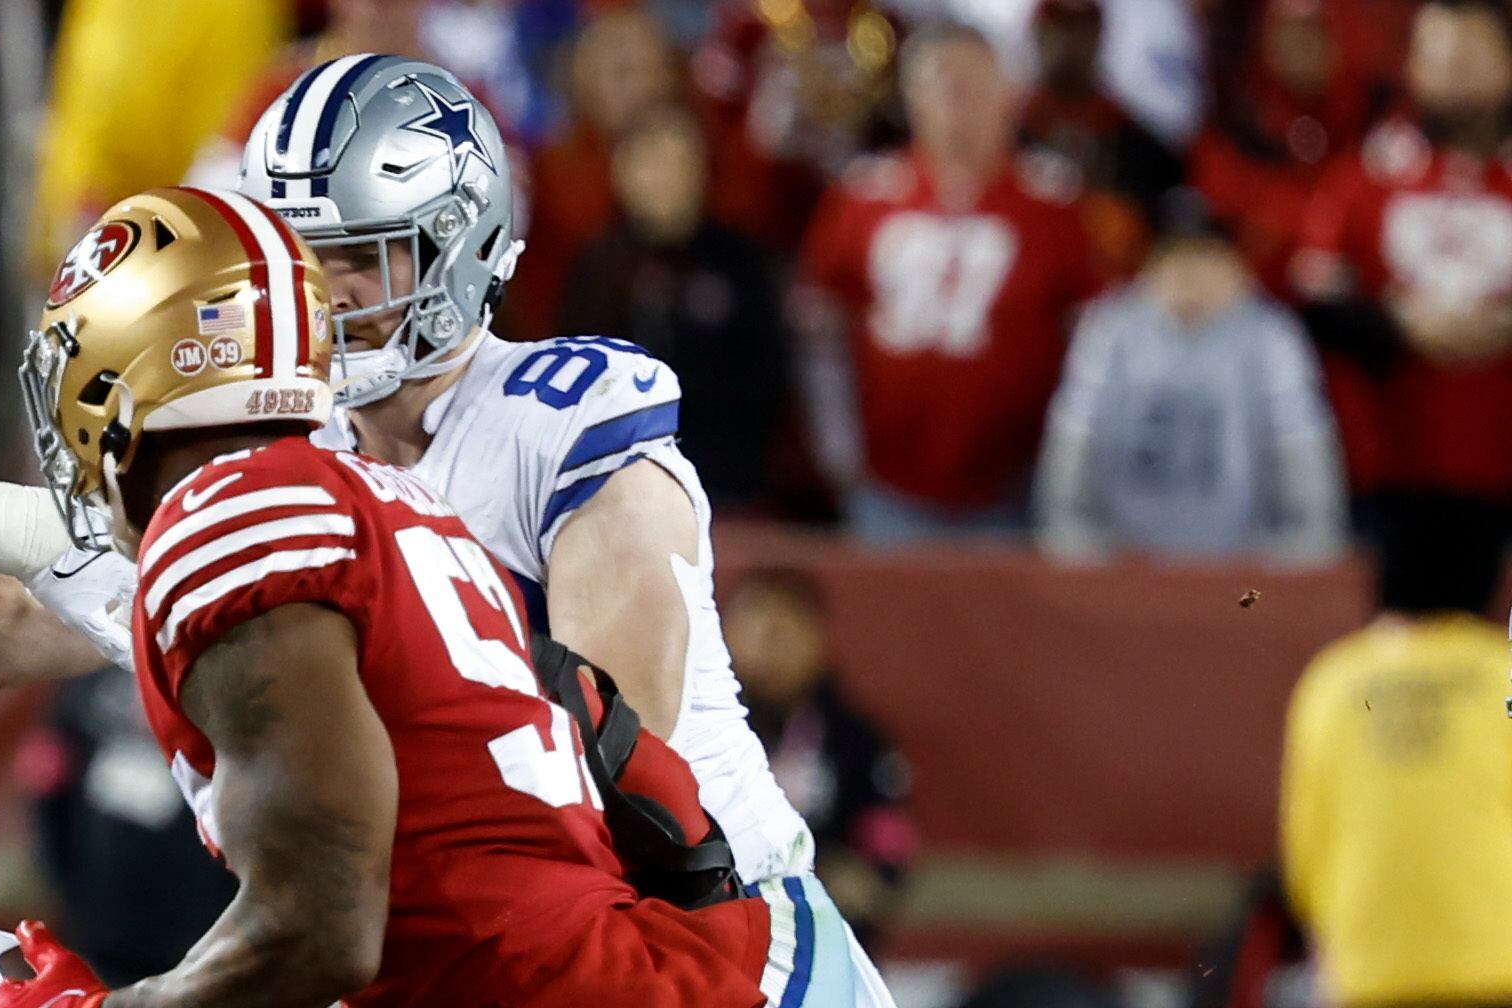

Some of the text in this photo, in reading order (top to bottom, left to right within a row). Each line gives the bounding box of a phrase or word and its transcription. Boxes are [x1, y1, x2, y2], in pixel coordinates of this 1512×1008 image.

[174, 347, 201, 367] JM
[214, 342, 239, 363] 39
[245, 388, 317, 416] 49ERS
